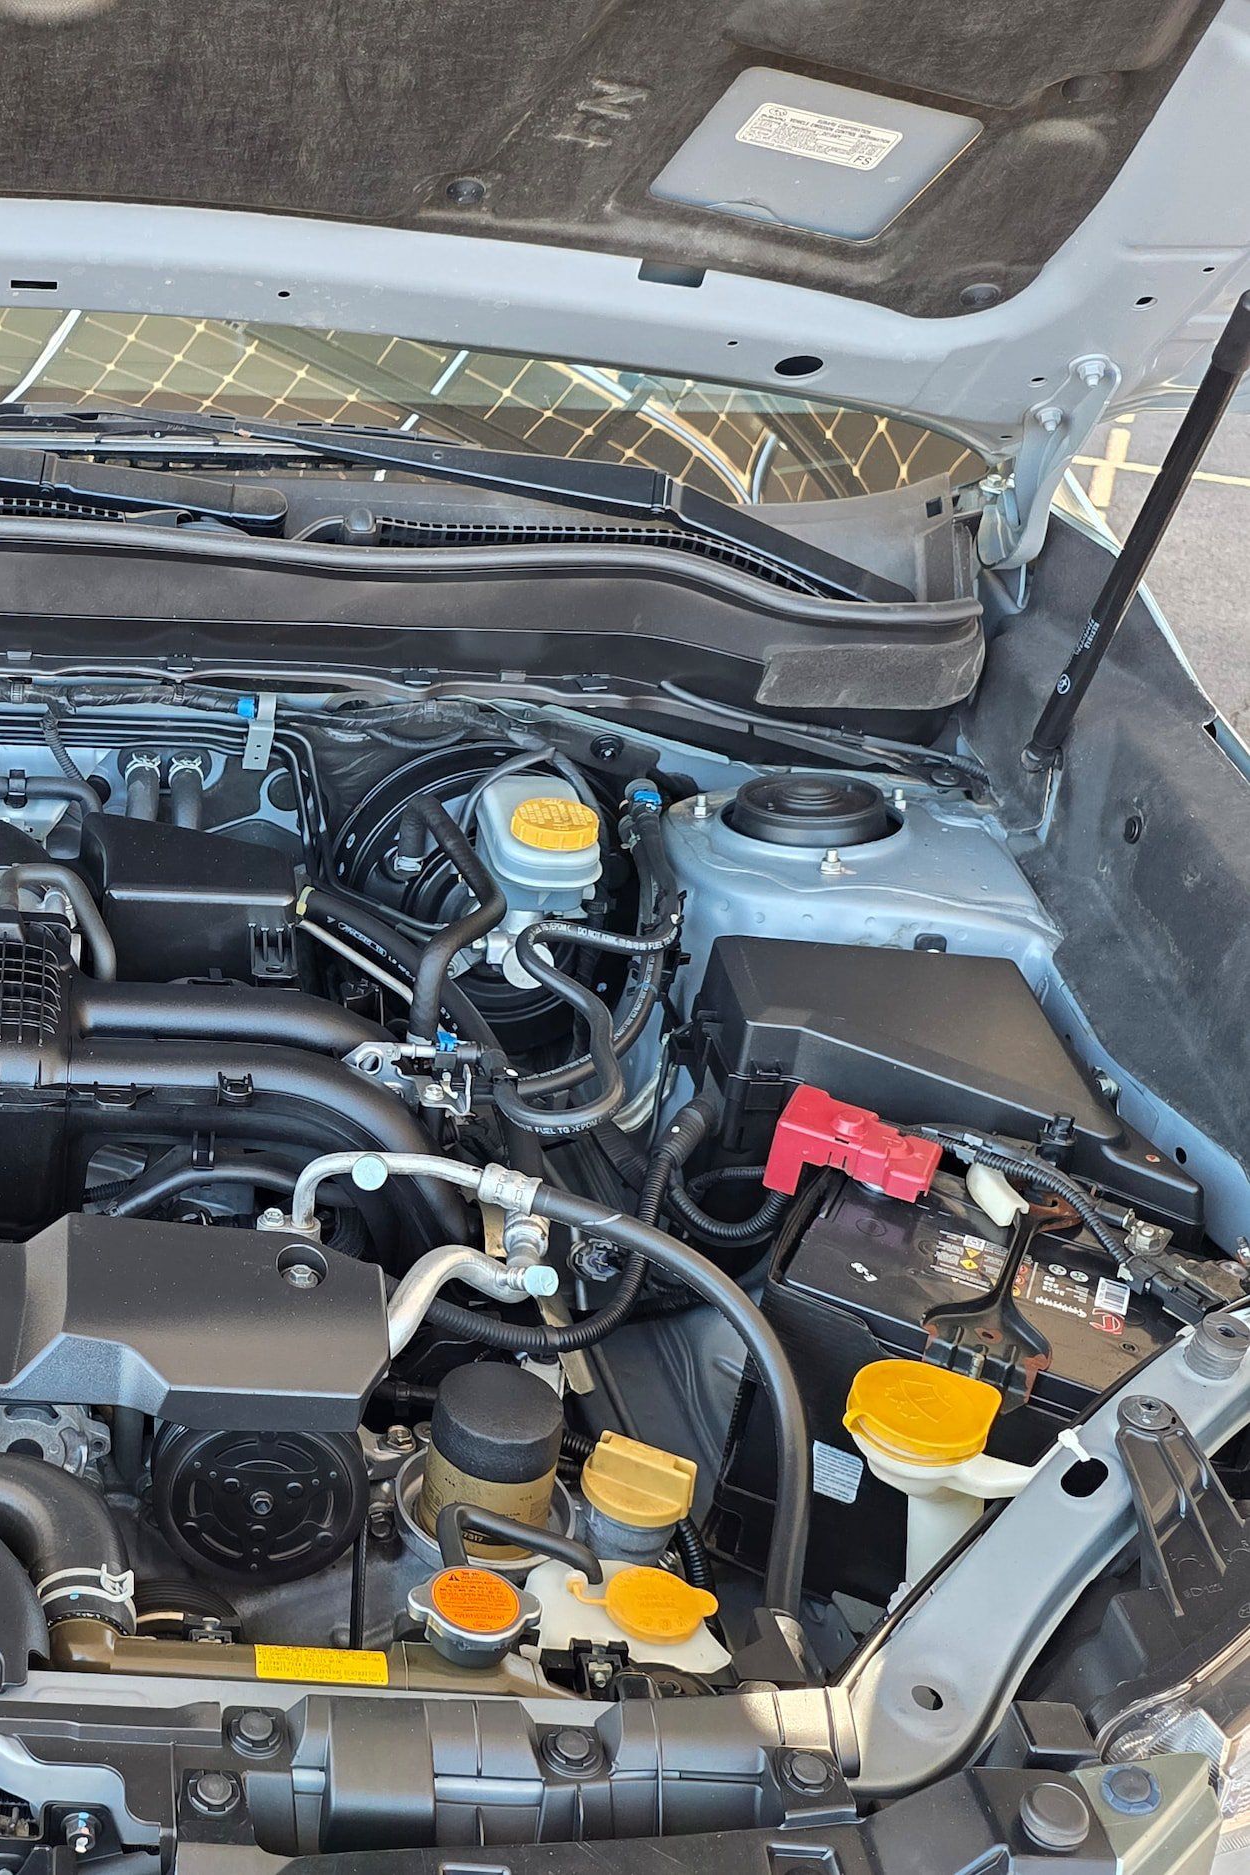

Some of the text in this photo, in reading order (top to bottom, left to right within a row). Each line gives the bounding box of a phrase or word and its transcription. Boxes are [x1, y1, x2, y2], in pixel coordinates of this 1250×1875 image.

[853, 155, 872, 166] FS
[577, 926, 587, 937] DO
[648, 939, 664, 950] FUEL
[534, 1126, 557, 1135] FUEL
[557, 1126, 571, 1135] TG
